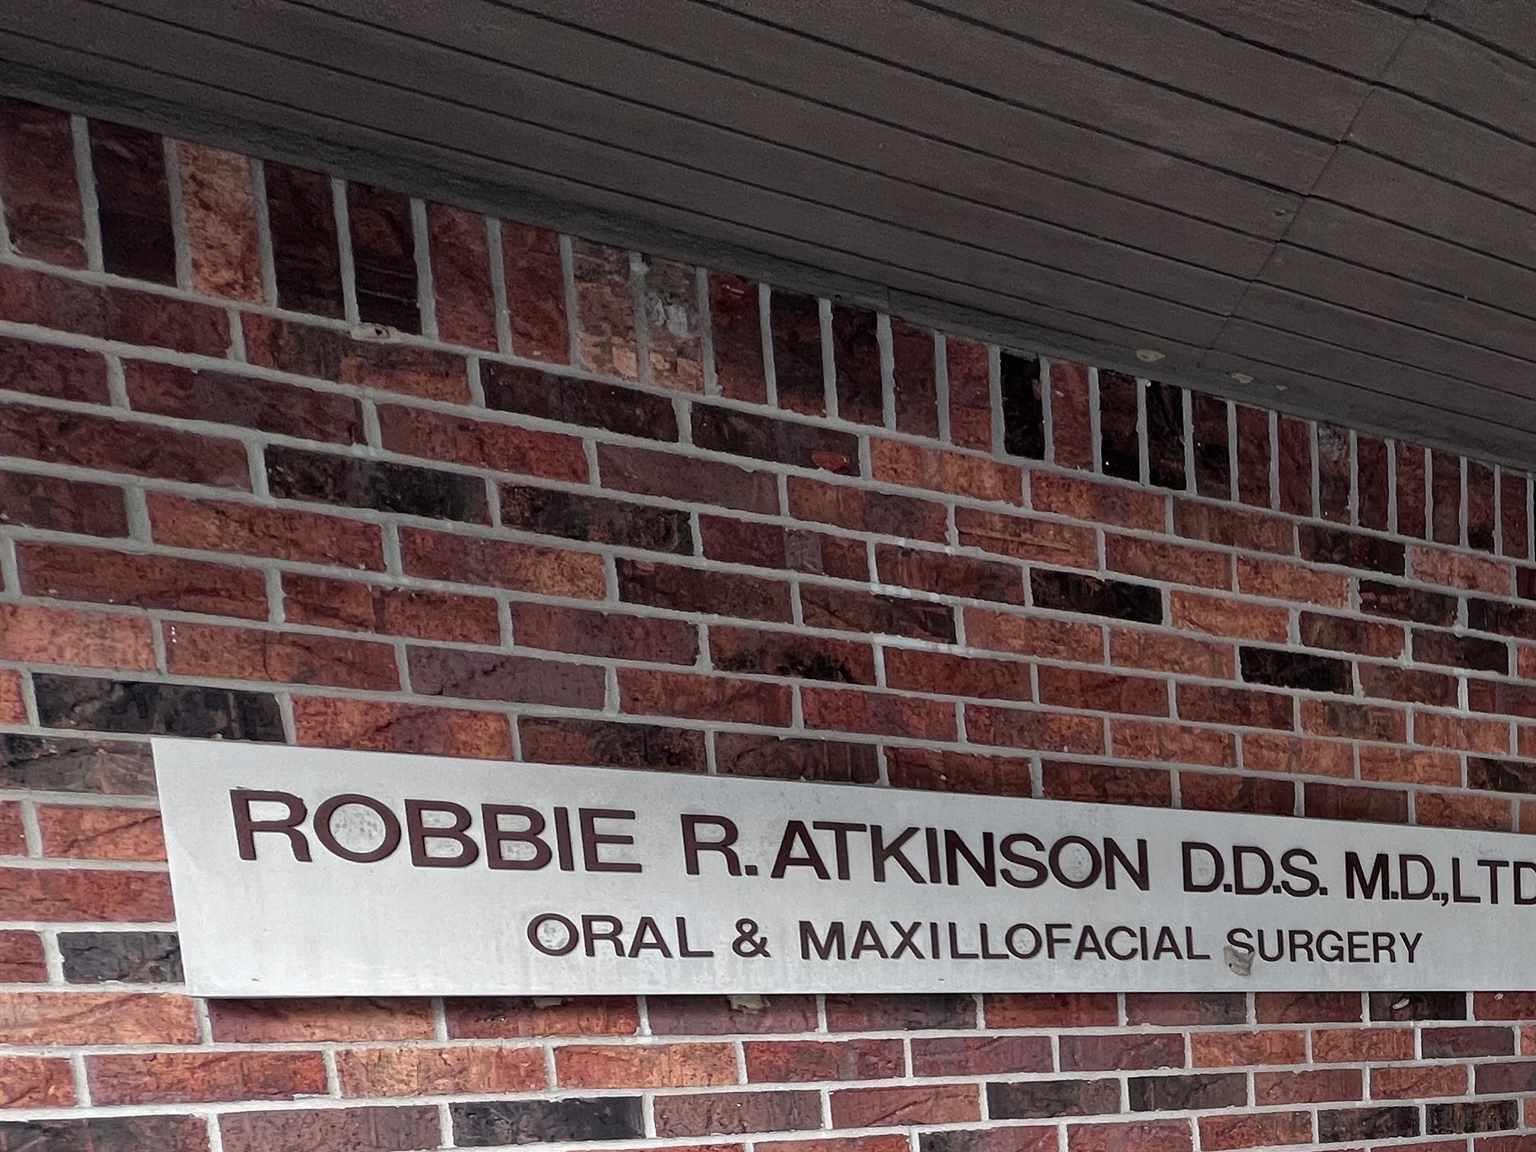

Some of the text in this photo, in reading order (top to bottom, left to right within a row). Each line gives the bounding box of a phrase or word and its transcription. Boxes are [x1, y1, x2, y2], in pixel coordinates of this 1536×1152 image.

[229, 788, 644, 874] ROBBIE
[1181, 840, 1329, 898] D.D.S.
[527, 913, 1423, 964] ORAL & MAXILLOFACIAL SURGERY
